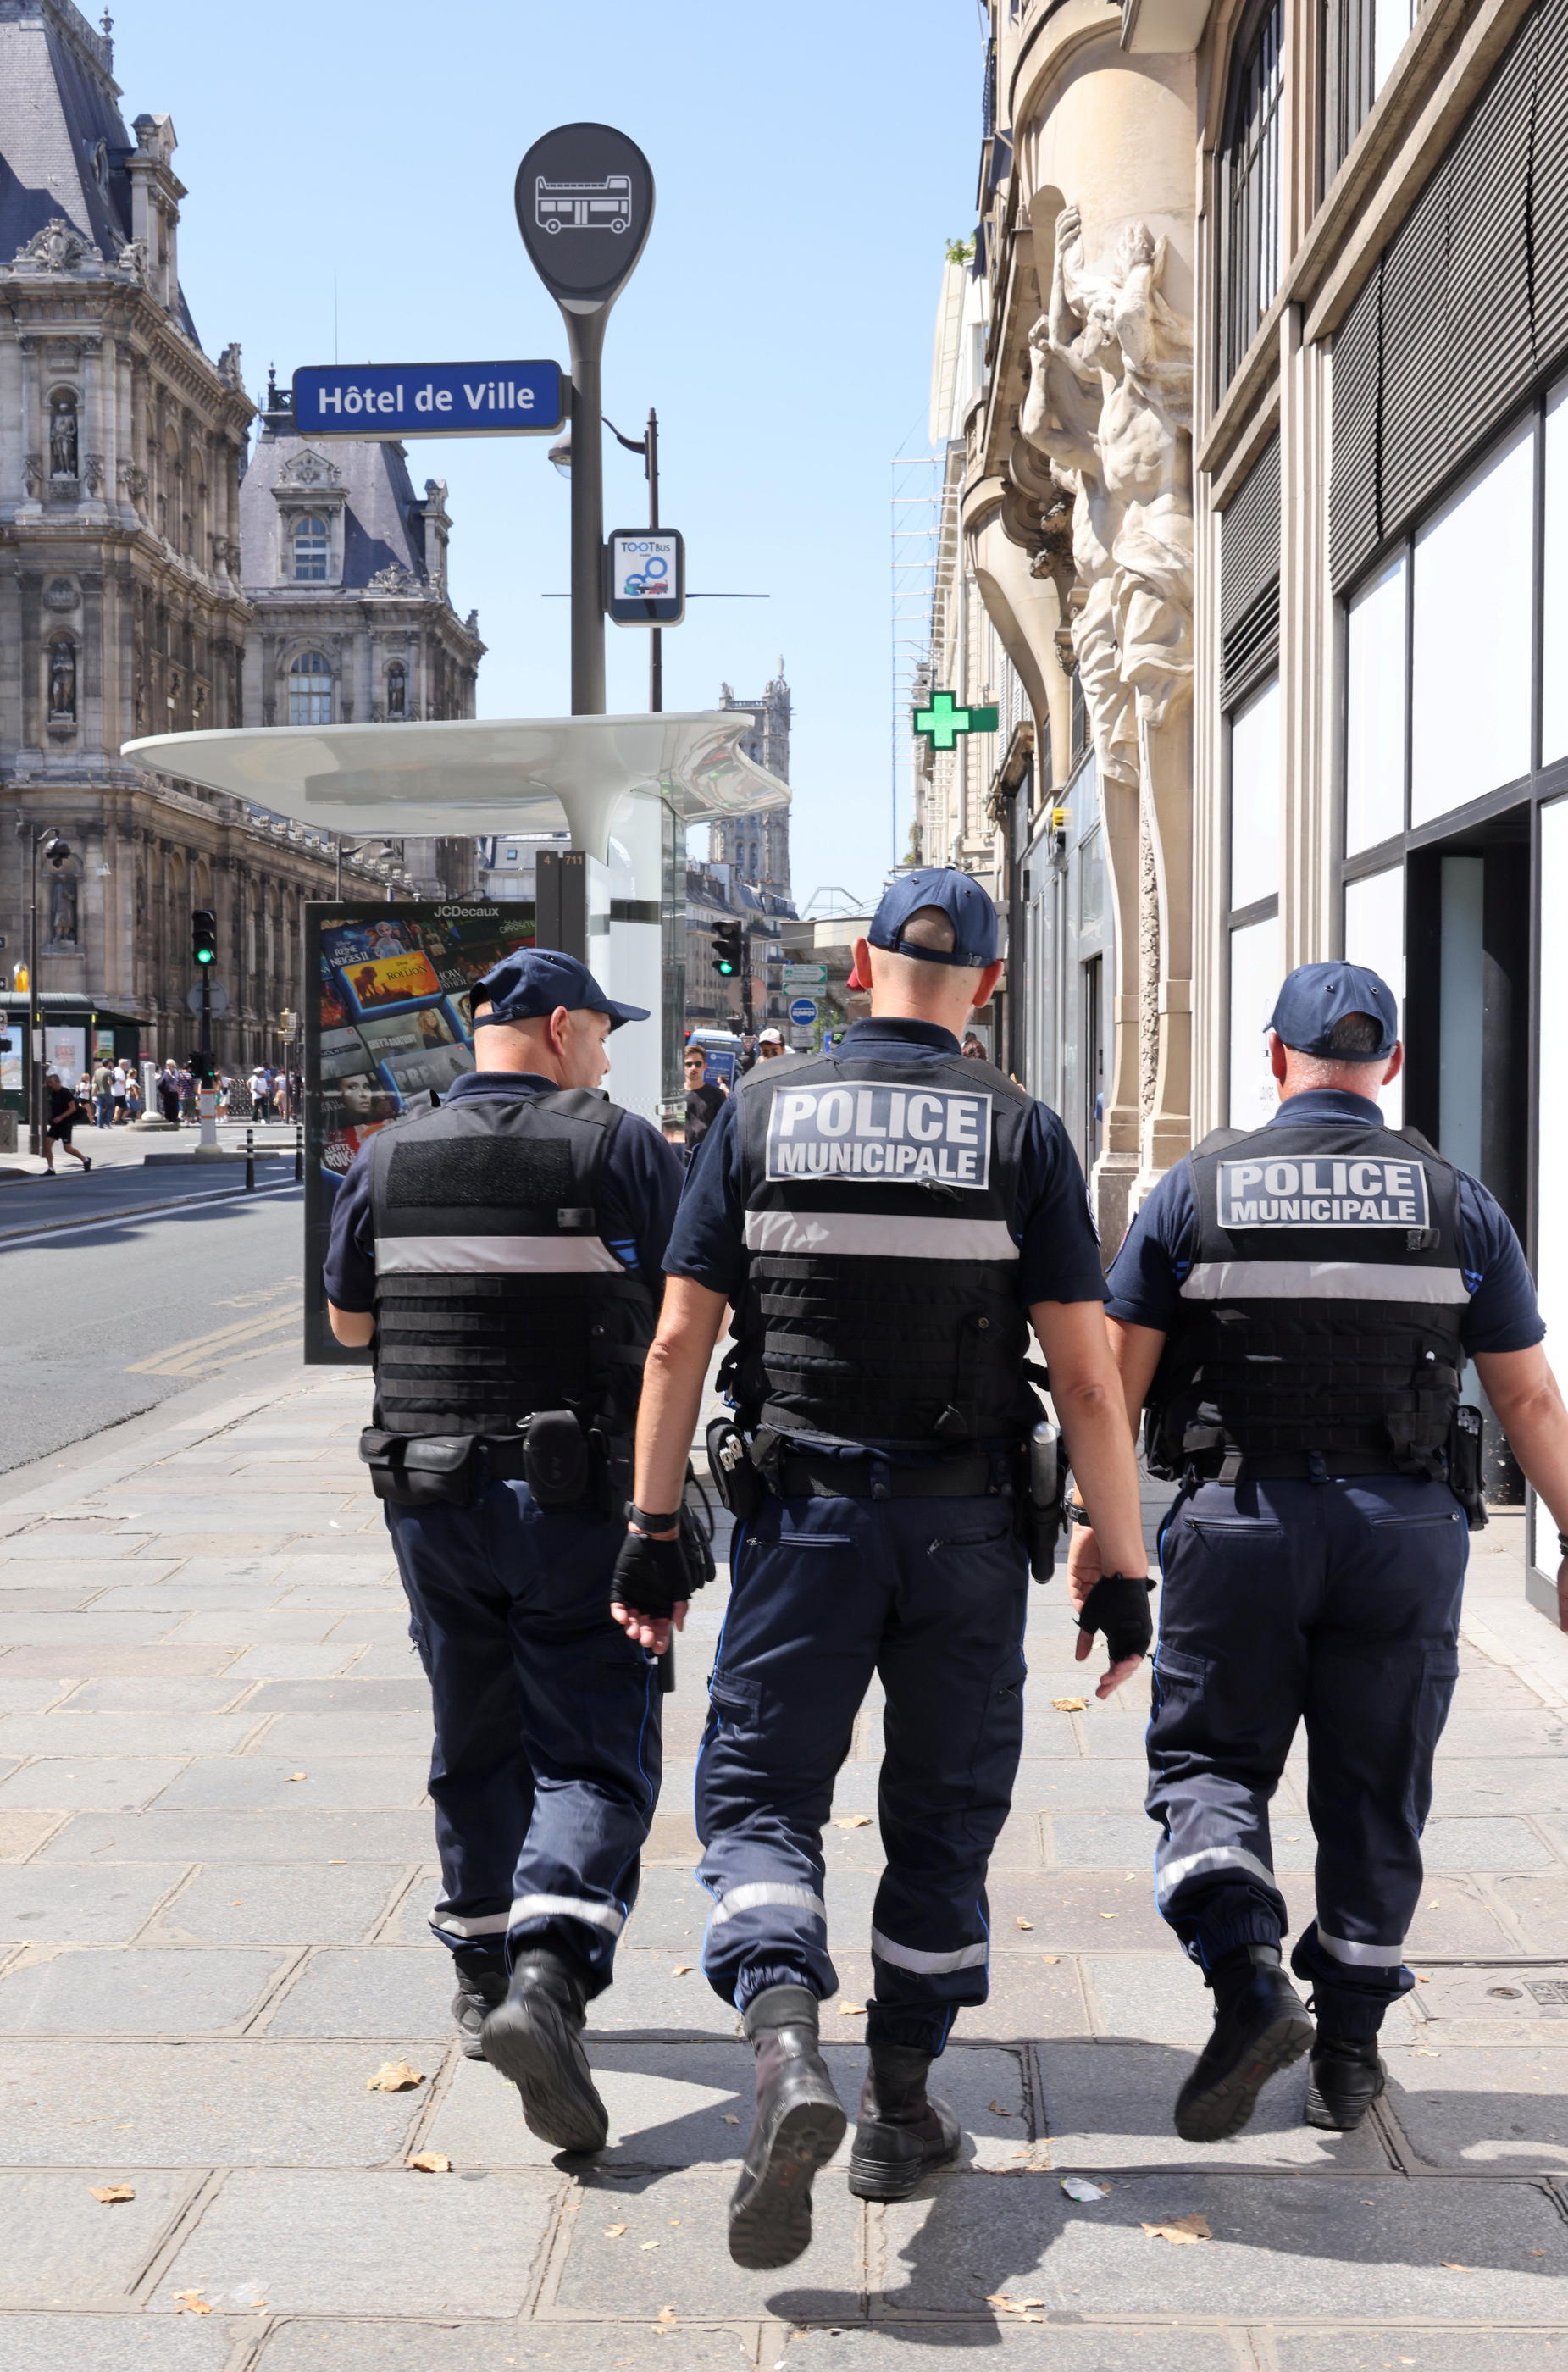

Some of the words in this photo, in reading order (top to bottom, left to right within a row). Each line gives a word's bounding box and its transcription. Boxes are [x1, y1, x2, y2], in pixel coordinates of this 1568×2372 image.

[319, 385, 405, 414] Hôtel
[414, 384, 453, 412] de
[463, 381, 535, 410] Ville
[543, 855, 551, 865] 4
[565, 855, 583, 865] 711
[434, 906, 499, 917] JCDecaux
[334, 945, 358, 956] REINE
[330, 953, 361, 967] NEIGES
[386, 967, 405, 981] ROI
[393, 1063, 447, 1091] PREY
[778, 1089, 978, 1144] POLICE
[324, 1144, 351, 1153] ALERTE
[777, 1142, 978, 1180] MUNICIPALE
[1230, 1161, 1415, 1198] POLICE
[1230, 1199, 1416, 1222] MUNICIPALE
